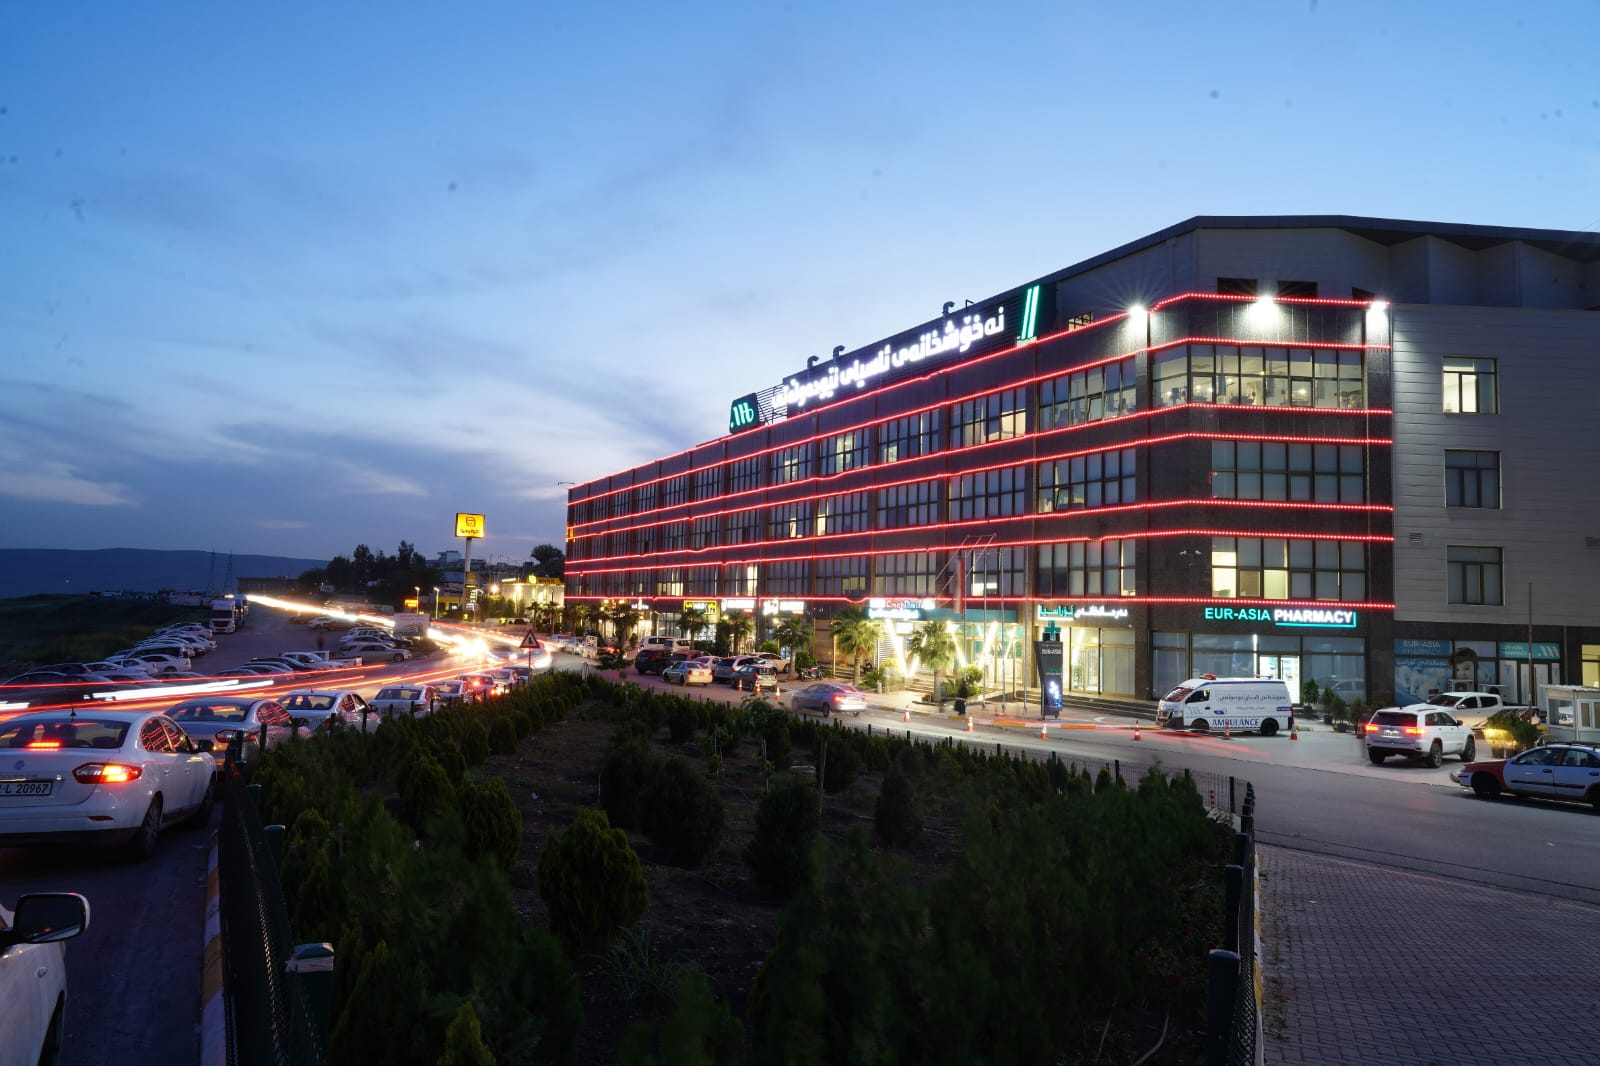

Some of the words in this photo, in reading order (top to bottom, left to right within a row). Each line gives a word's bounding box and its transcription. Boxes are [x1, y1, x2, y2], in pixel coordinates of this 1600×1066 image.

[1204, 607, 1271, 621] EUR-ASIA
[1274, 608, 1353, 623] PHARMACY
[1403, 639, 1440, 648] EUR-ASIA
[15, 783, 49, 794] 20967
